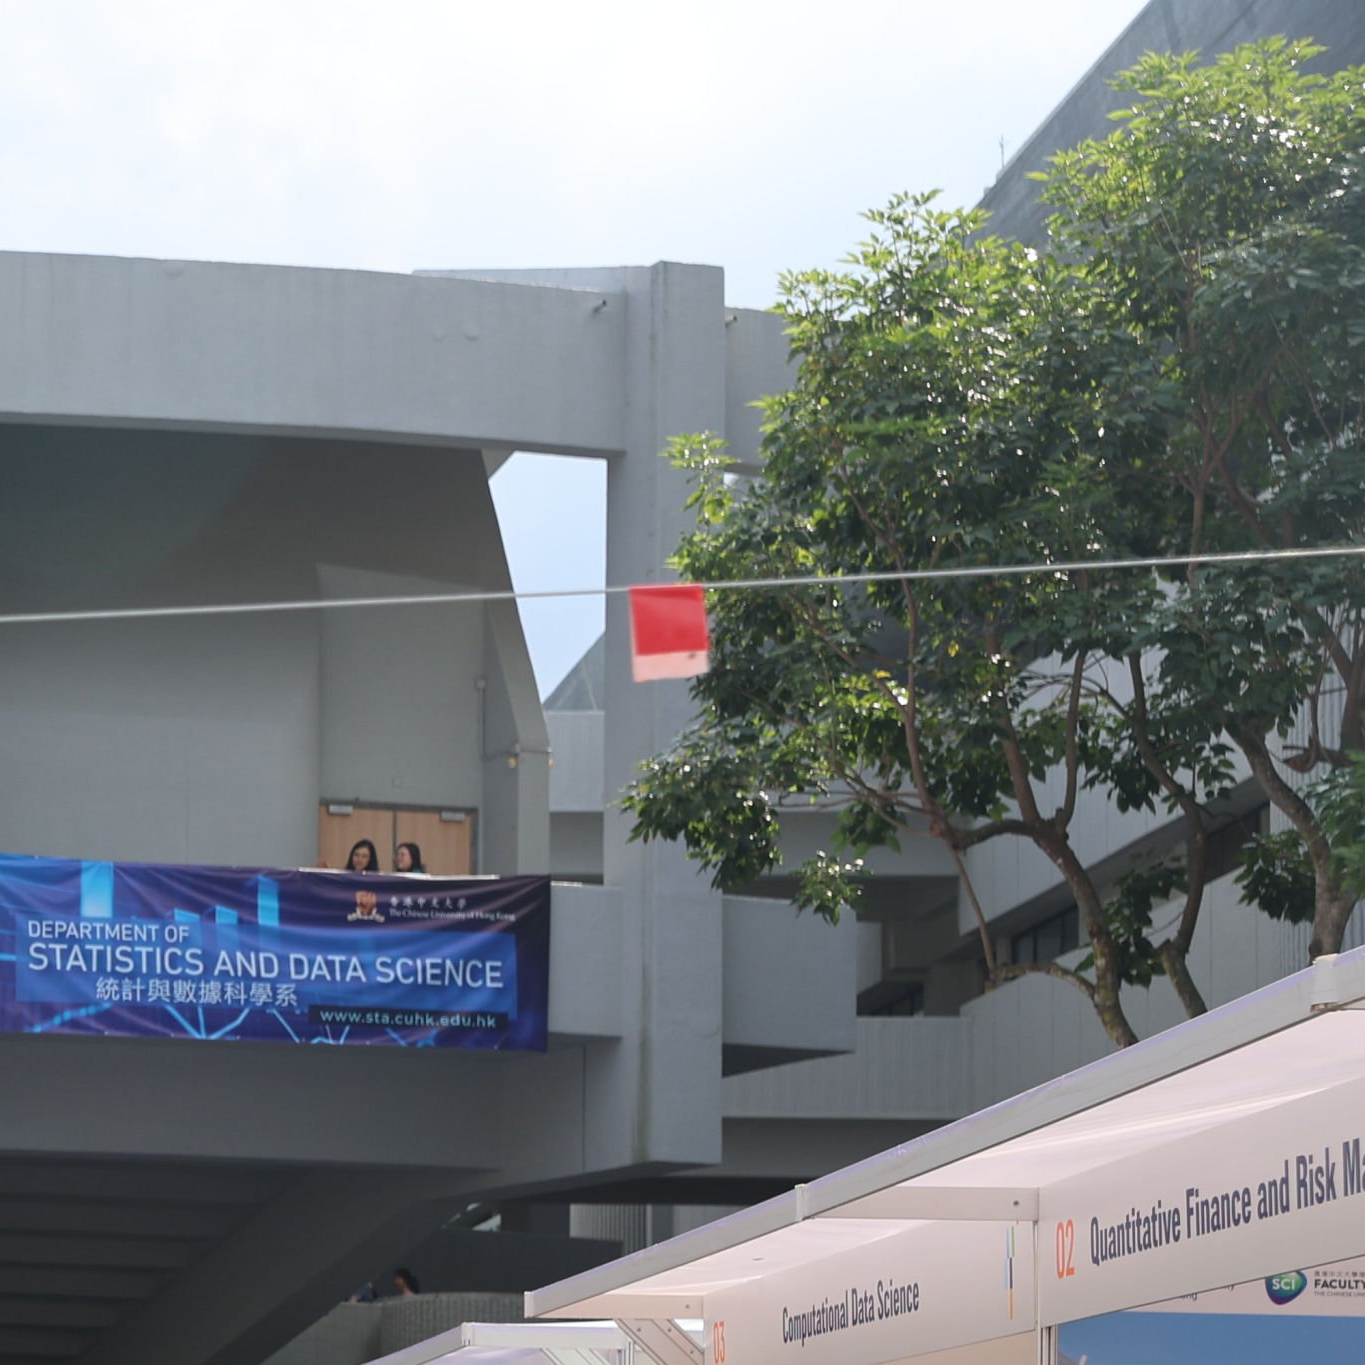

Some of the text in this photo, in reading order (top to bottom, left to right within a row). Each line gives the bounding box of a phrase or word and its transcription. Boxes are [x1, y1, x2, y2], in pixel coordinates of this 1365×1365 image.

[28, 920, 190, 944] DEPARTMENT OF
[28, 942, 504, 988] STATISTICS AND DATA SCIENCE
[95, 977, 298, 1007] 統計與數據科學系
[320, 1010, 497, 1029] www.sta.cuhk.edu.hk
[1055, 1218, 1076, 1280] 02
[1089, 1199, 1182, 1267] Quantitative
[1185, 1186, 1252, 1240] Finance
[1257, 1158, 1291, 1221] and
[1295, 1146, 1338, 1211] Risk
[1272, 1278, 1296, 1291] SCI
[713, 1278, 920, 1365] 03 Computational Data Science
